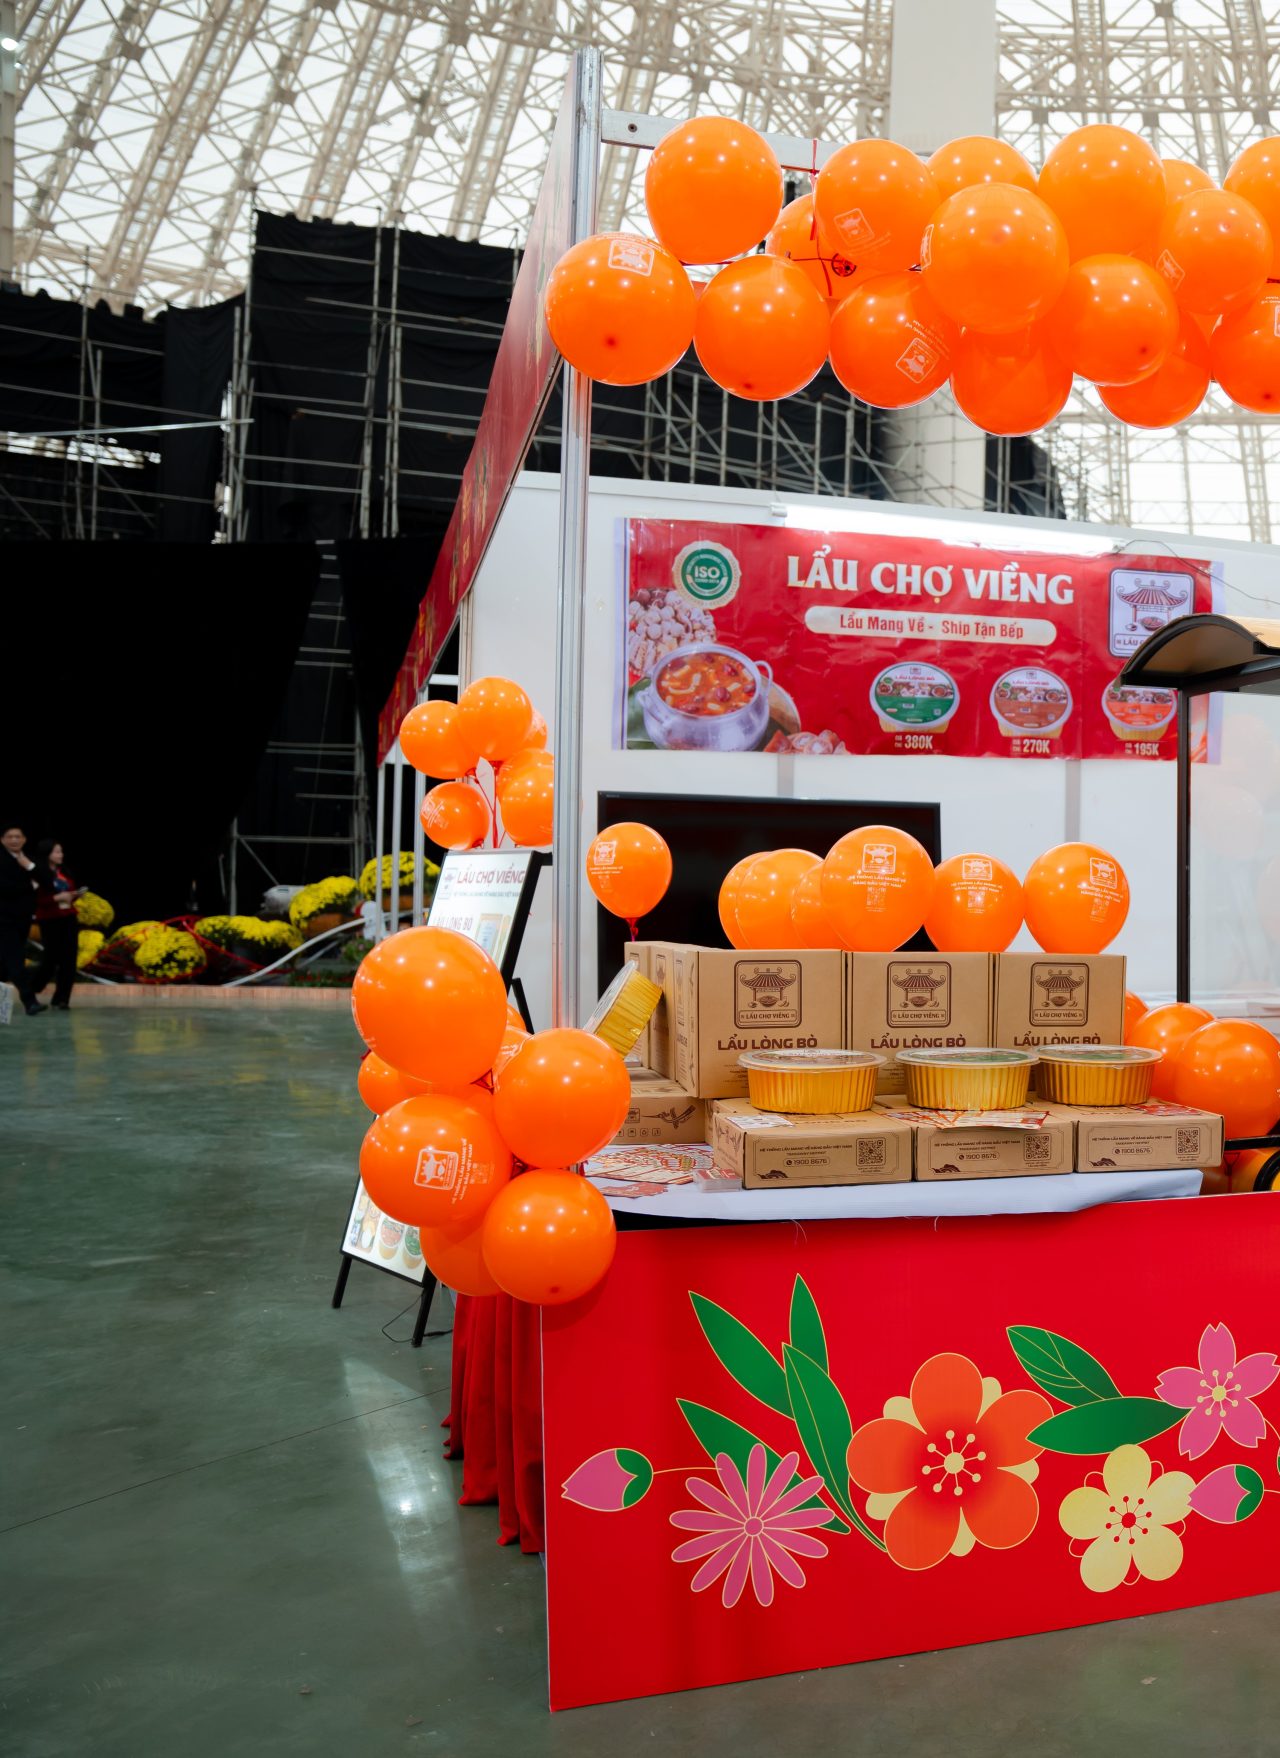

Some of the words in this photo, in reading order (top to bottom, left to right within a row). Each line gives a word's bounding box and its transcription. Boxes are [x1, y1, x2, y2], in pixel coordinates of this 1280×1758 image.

[694, 565, 720, 578] ISO
[787, 544, 859, 591] LẨU
[870, 562, 953, 604] CHỢ
[962, 562, 1075, 605] VIỀNG
[840, 614, 863, 630] Lẩu
[867, 616, 903, 634] Mang
[908, 616, 925, 633] Về
[942, 621, 970, 637] Ship
[975, 621, 996, 640] Tận
[1000, 620, 1024, 639] Bếp
[905, 734, 933, 749] 380K
[1023, 739, 1050, 753] 270K
[1134, 743, 1159, 756] 195K
[476, 869, 496, 887] CHỢ
[718, 1033, 748, 1051] LẨU
[751, 1035, 793, 1050] LÒNG
[796, 1034, 818, 1049] BÒ
[870, 1032, 899, 1049] LẨU
[903, 1034, 943, 1049] LÒNG
[946, 1033, 966, 1048] BÒ
[1014, 1030, 1040, 1047] LẨU
[1043, 1033, 1080, 1045] LÒNG
[1083, 1032, 1101, 1045] BÒ
